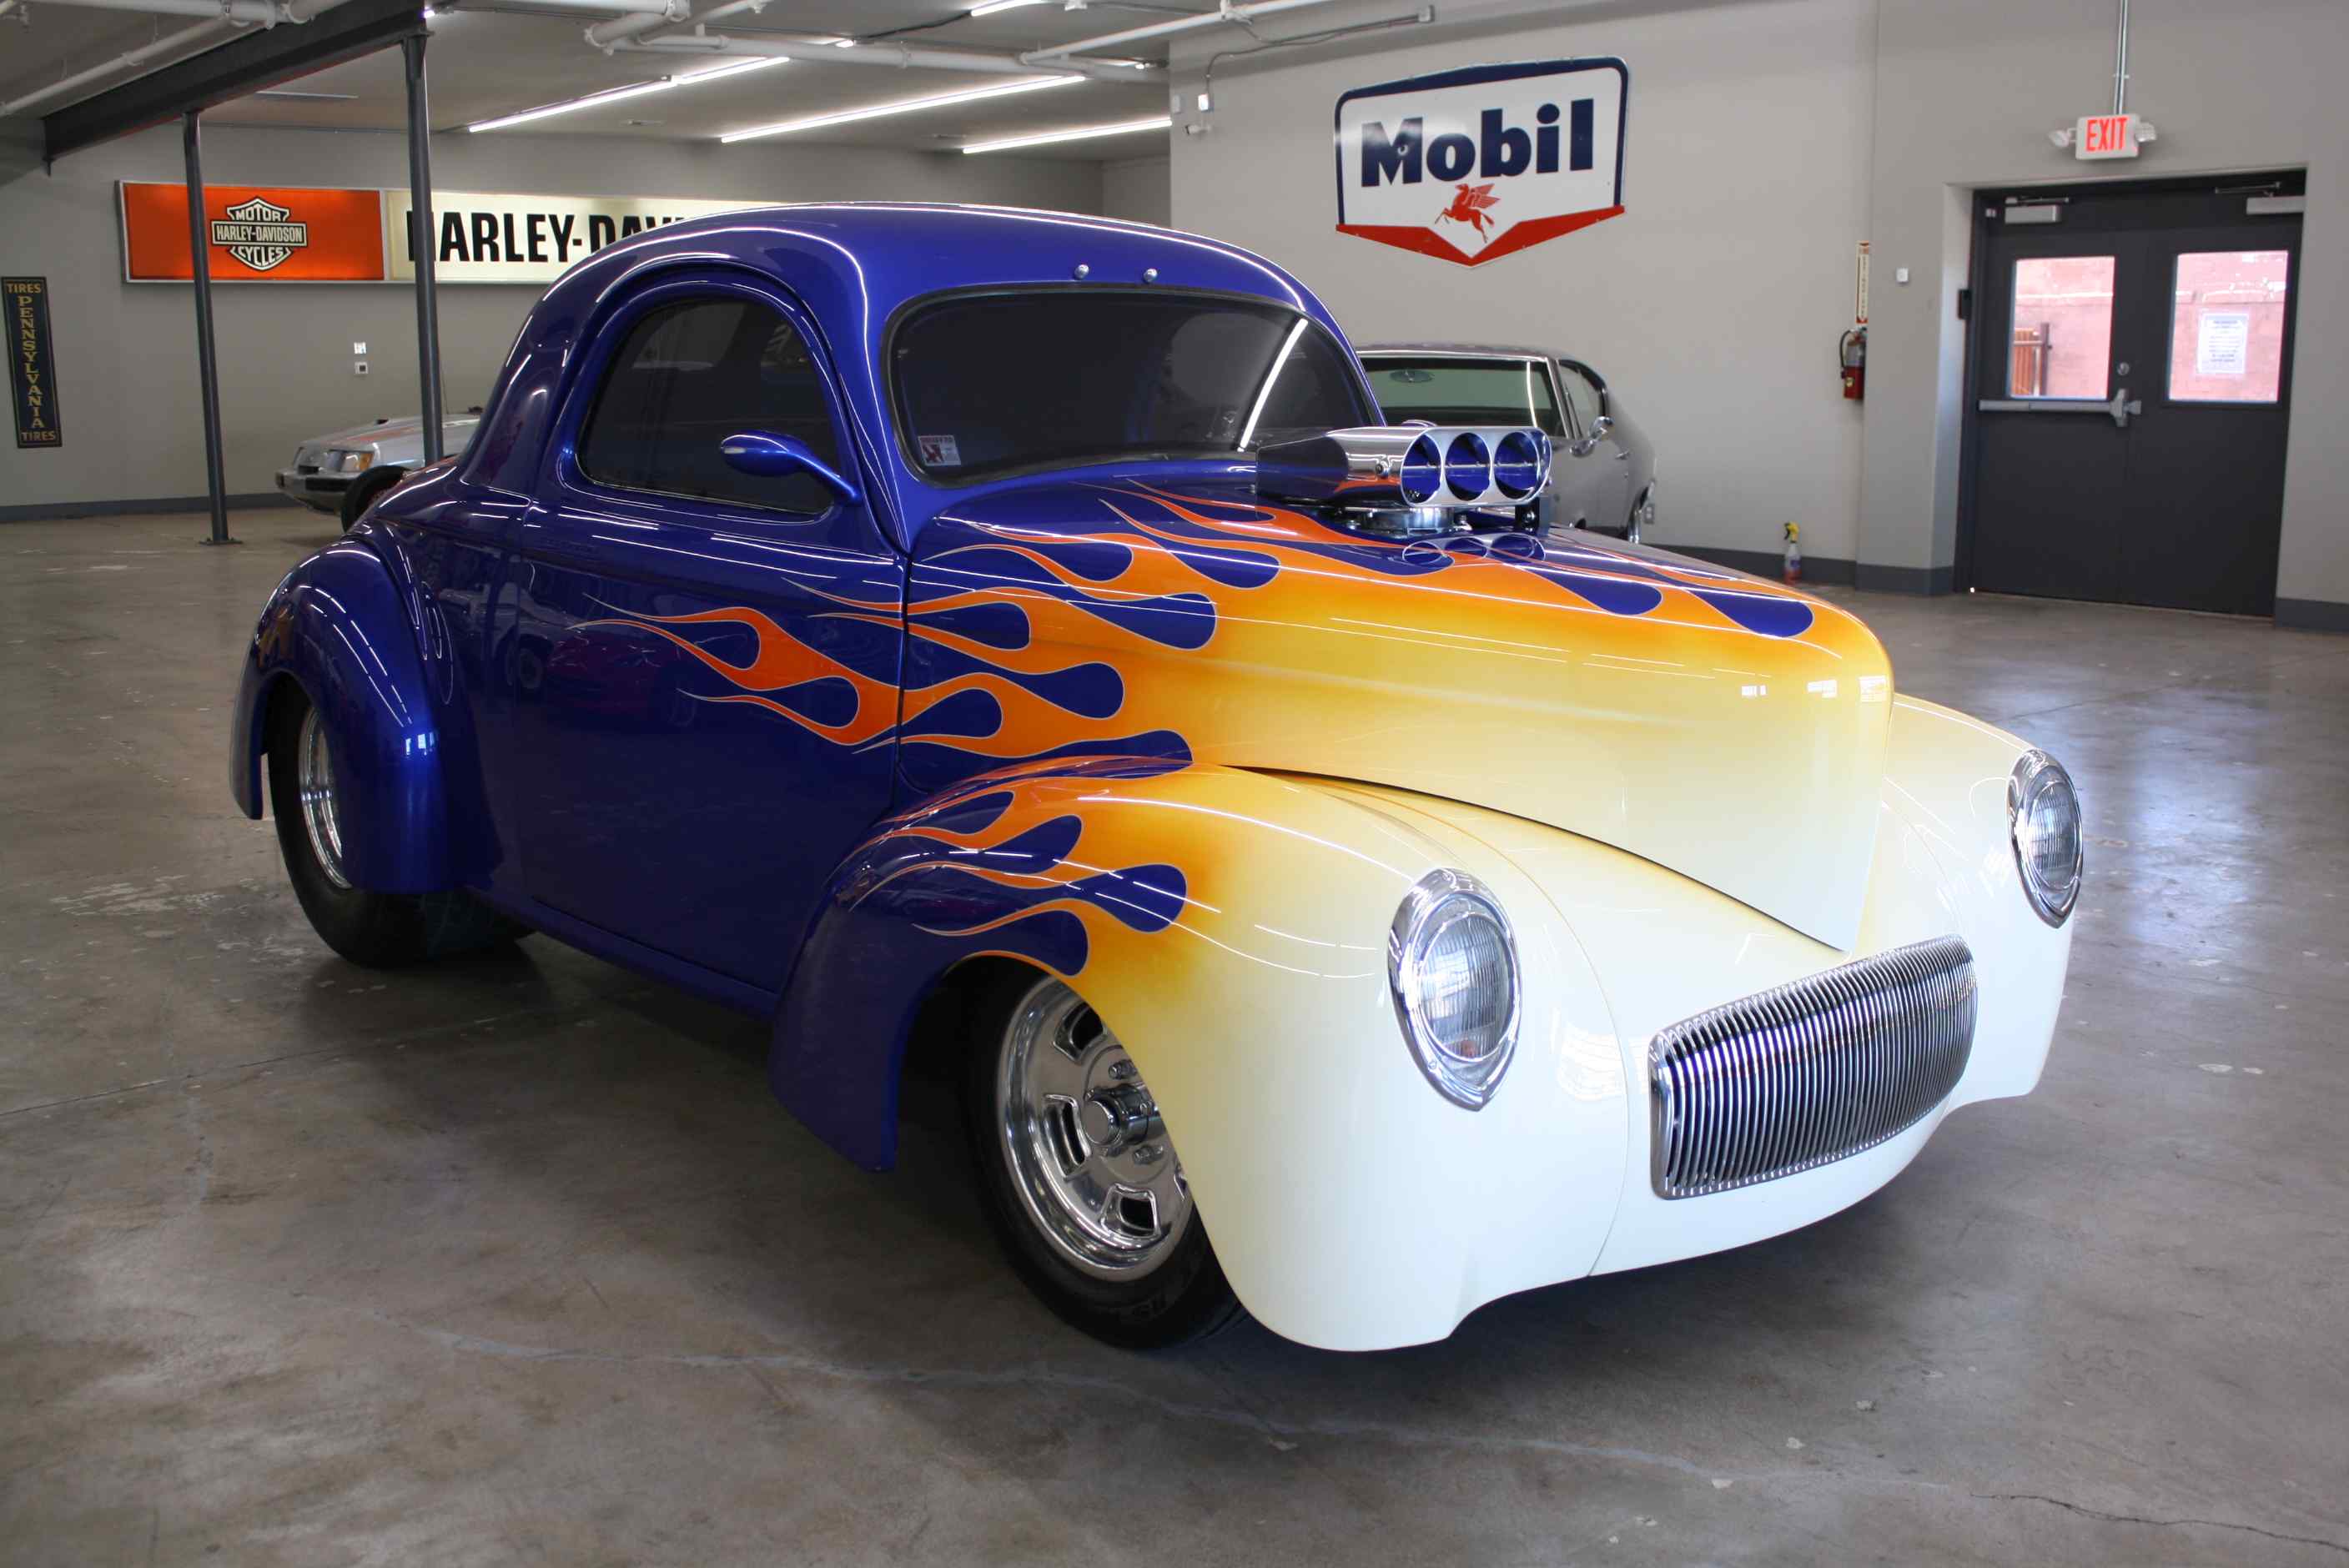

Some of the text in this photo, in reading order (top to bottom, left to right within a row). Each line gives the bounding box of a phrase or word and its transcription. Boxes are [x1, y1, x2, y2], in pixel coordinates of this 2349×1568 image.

[1361, 98, 1595, 188] Mobil
[2086, 117, 2128, 152] EXIT
[234, 203, 282, 222] MOTOR
[216, 225, 303, 243] HARLEY-DAVIDSON
[406, 211, 685, 263] ARLEY-D
[238, 245, 284, 266] CYCLES
[6, 283, 42, 294] TIRES
[18, 295, 45, 429] PENNSYLVANIA
[21, 430, 56, 441] TIRES
